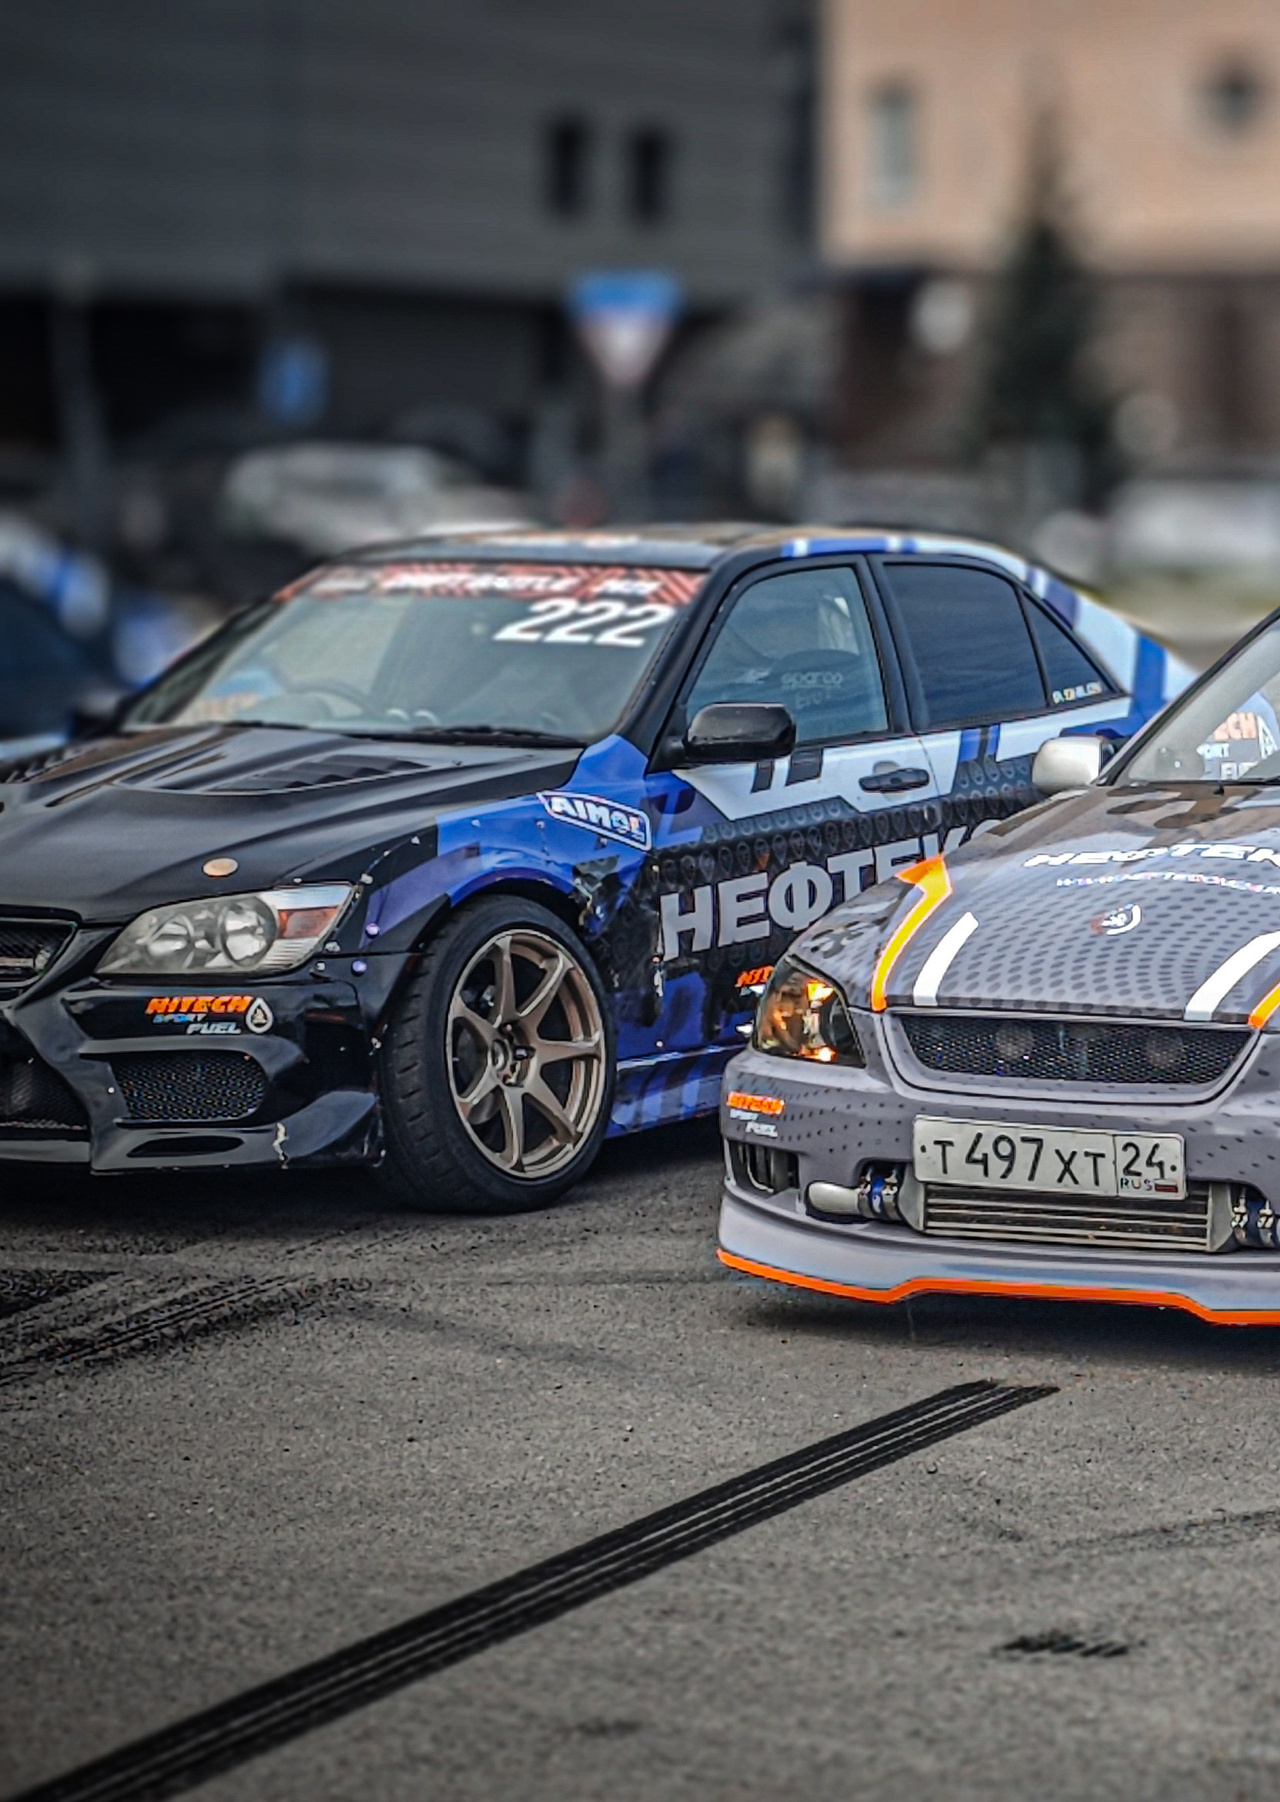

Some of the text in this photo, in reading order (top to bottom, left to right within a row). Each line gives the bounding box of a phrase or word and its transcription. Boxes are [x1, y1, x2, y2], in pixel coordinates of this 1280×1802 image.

[491, 598, 676, 648] 222
[781, 669, 845, 688] sparco
[144, 995, 254, 1014] HITECH
[186, 1021, 242, 1035] FUEL
[1121, 1141, 1166, 1180] 24
[1120, 1177, 1153, 1192] RUS
